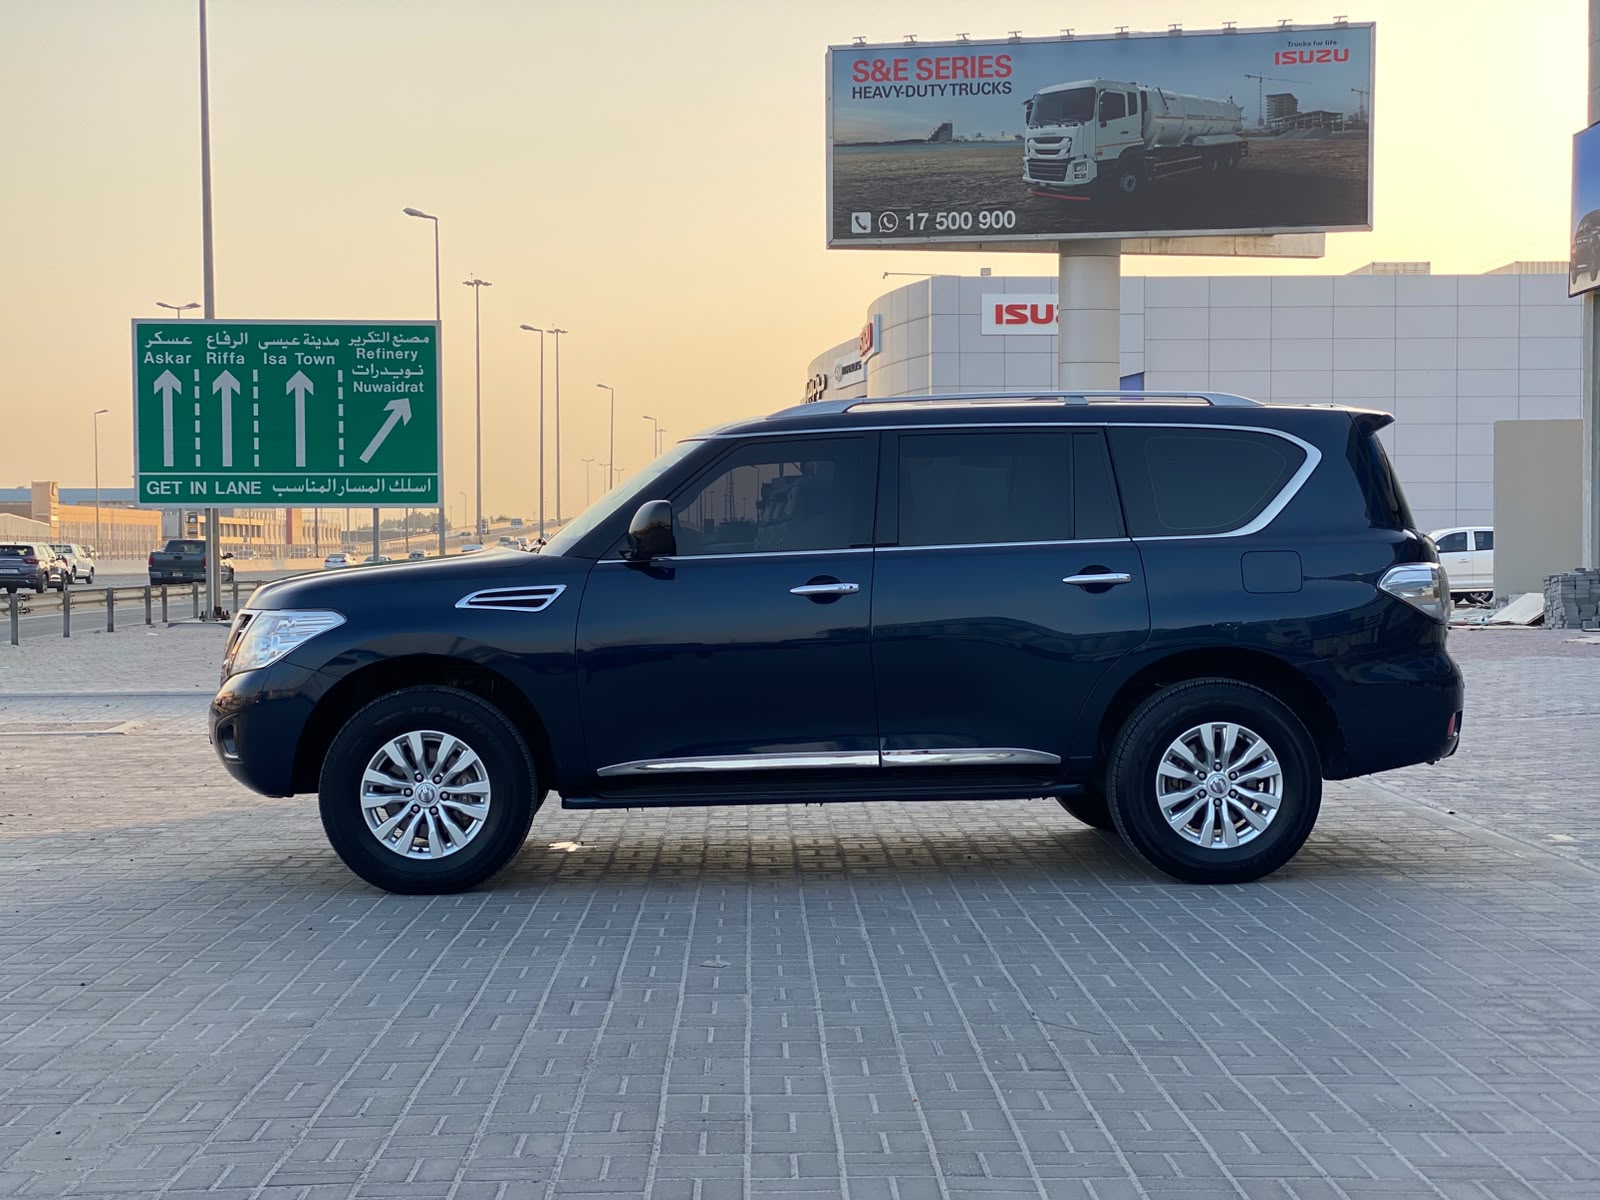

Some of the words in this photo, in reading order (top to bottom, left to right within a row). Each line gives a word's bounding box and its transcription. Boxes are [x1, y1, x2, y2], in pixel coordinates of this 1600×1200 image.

[1274, 48, 1349, 65] ISUZU
[852, 58, 909, 83] S&E
[915, 54, 1013, 81] SERIES
[852, 83, 947, 100] HEAVY-DUTY
[949, 81, 1012, 97] TRUCKS
[905, 212, 929, 231] 17
[935, 212, 973, 230] 500
[978, 210, 1016, 229] 900
[995, 304, 1058, 325] ISU
[144, 331, 193, 348] عسكر
[206, 330, 248, 349] الرفاع
[258, 337, 301, 350] عيسى
[303, 333, 340, 349] مدينة
[348, 331, 390, 346] التكرير
[392, 334, 430, 347] مصنع
[143, 351, 192, 364] Askar
[206, 351, 245, 364] Riffa
[263, 352, 287, 365] Isa
[294, 352, 335, 365] Town
[356, 347, 418, 361] Refinery
[352, 363, 424, 379] نويدرات
[353, 381, 424, 393] Nuwaidrat
[146, 480, 183, 495] GET
[190, 481, 207, 495] IN
[215, 481, 262, 495] LANE
[272, 477, 337, 497] المناسب
[336, 477, 385, 496] المسار
[388, 477, 431, 493] اسلك
